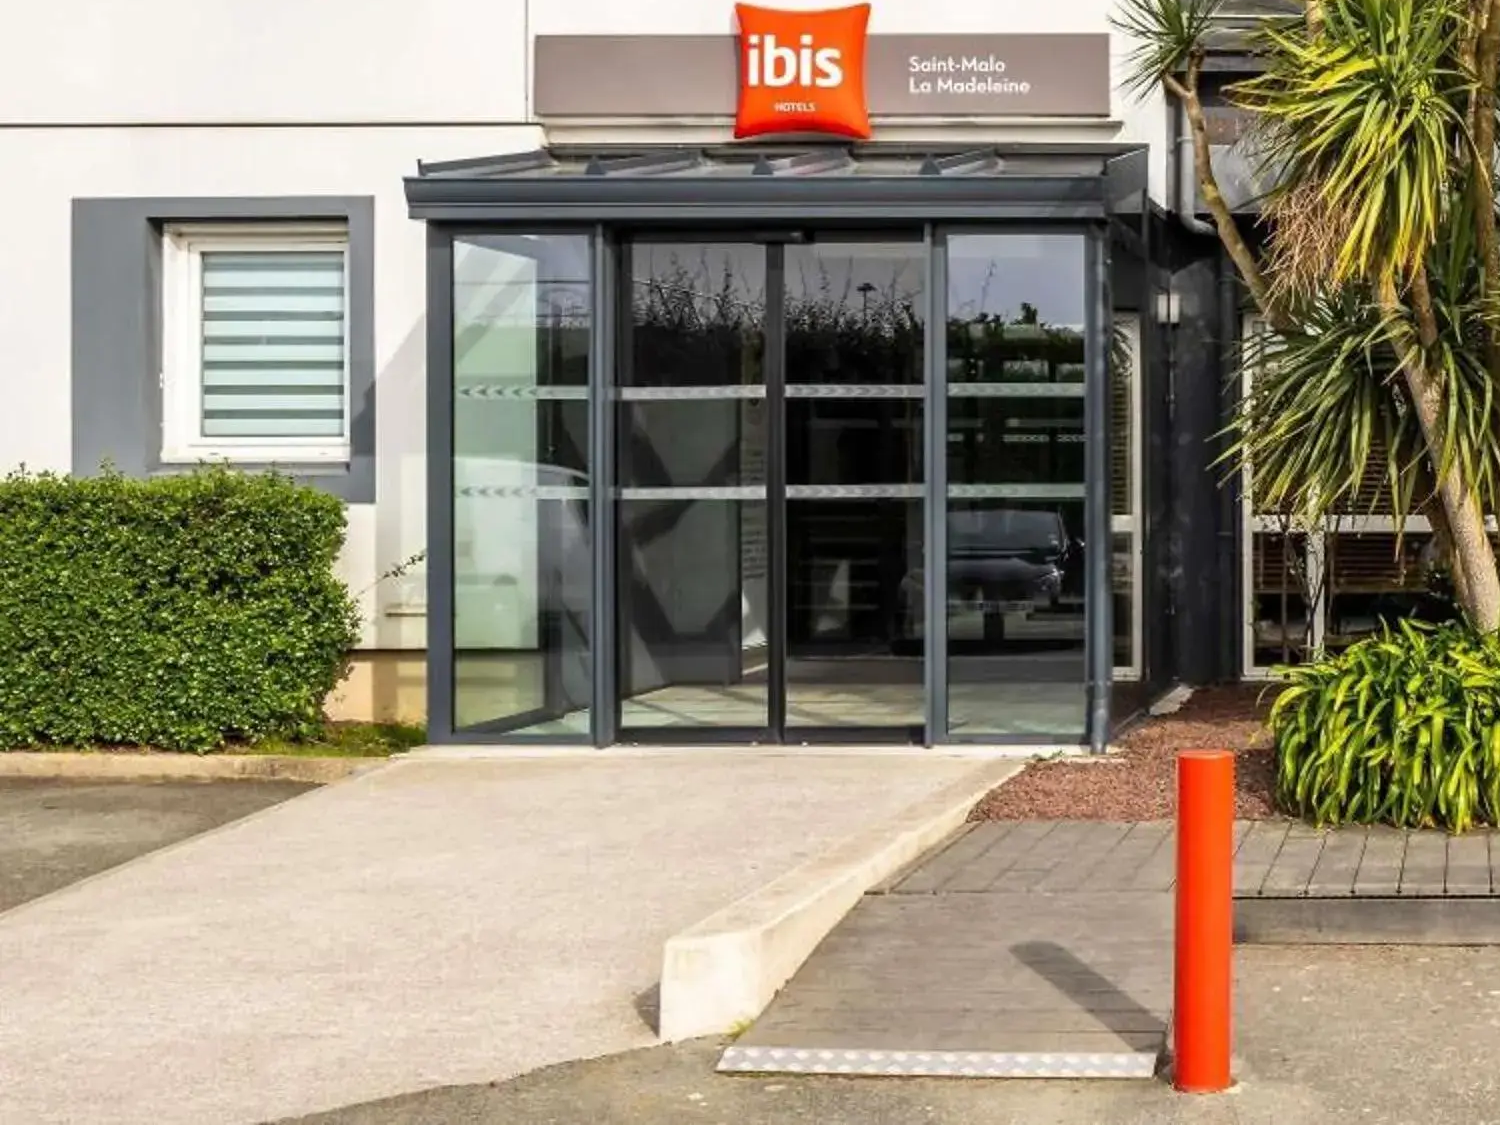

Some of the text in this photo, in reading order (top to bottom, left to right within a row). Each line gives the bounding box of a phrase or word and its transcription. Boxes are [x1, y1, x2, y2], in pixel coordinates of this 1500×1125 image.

[748, 34, 843, 87] ibis
[909, 55, 1006, 72] Saint-Malo
[909, 76, 1031, 93] La Madeleine
[774, 102, 815, 112] HOTELS
